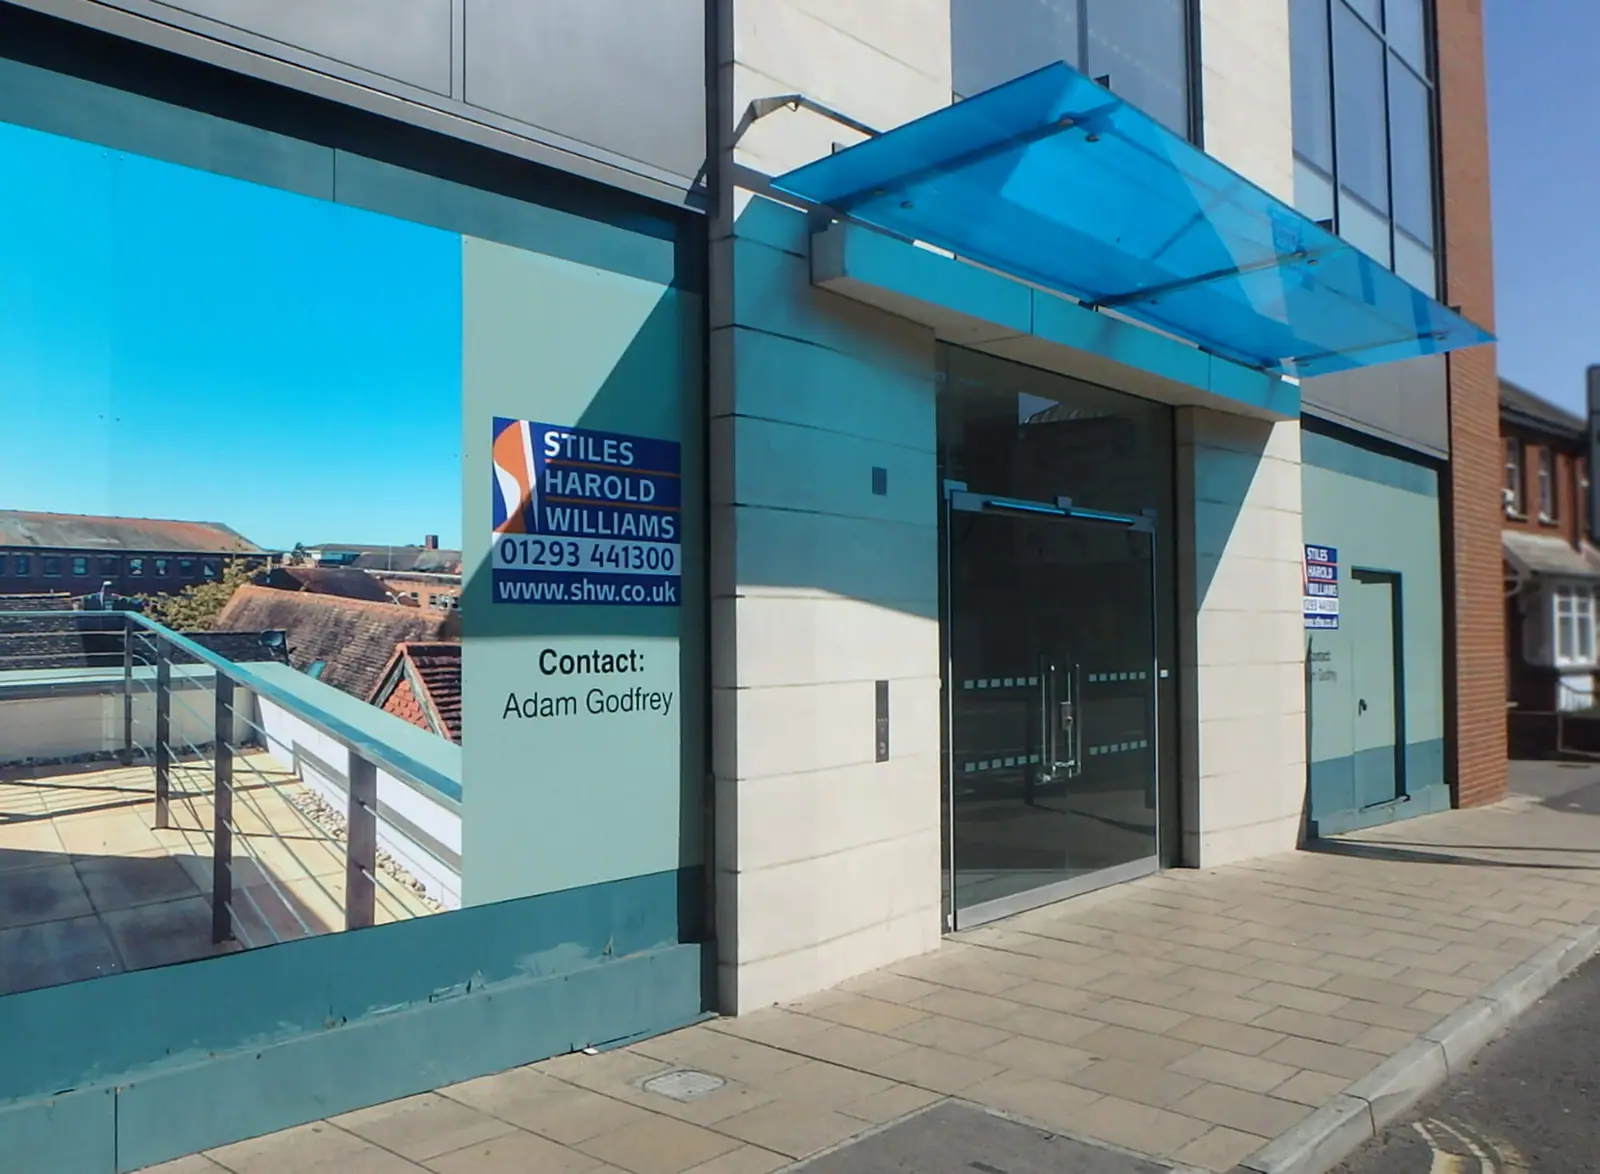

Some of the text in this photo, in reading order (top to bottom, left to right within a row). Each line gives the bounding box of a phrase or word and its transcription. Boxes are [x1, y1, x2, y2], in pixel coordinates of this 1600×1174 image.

[544, 431, 634, 466] STILES
[545, 469, 655, 502] HAROLD
[545, 506, 675, 540] WILLIAMS
[500, 538, 674, 571] 01293 441300
[499, 578, 676, 603] www.shw.co.uk
[538, 648, 645, 676] Contact:
[502, 687, 673, 720] Adam Godfrey
